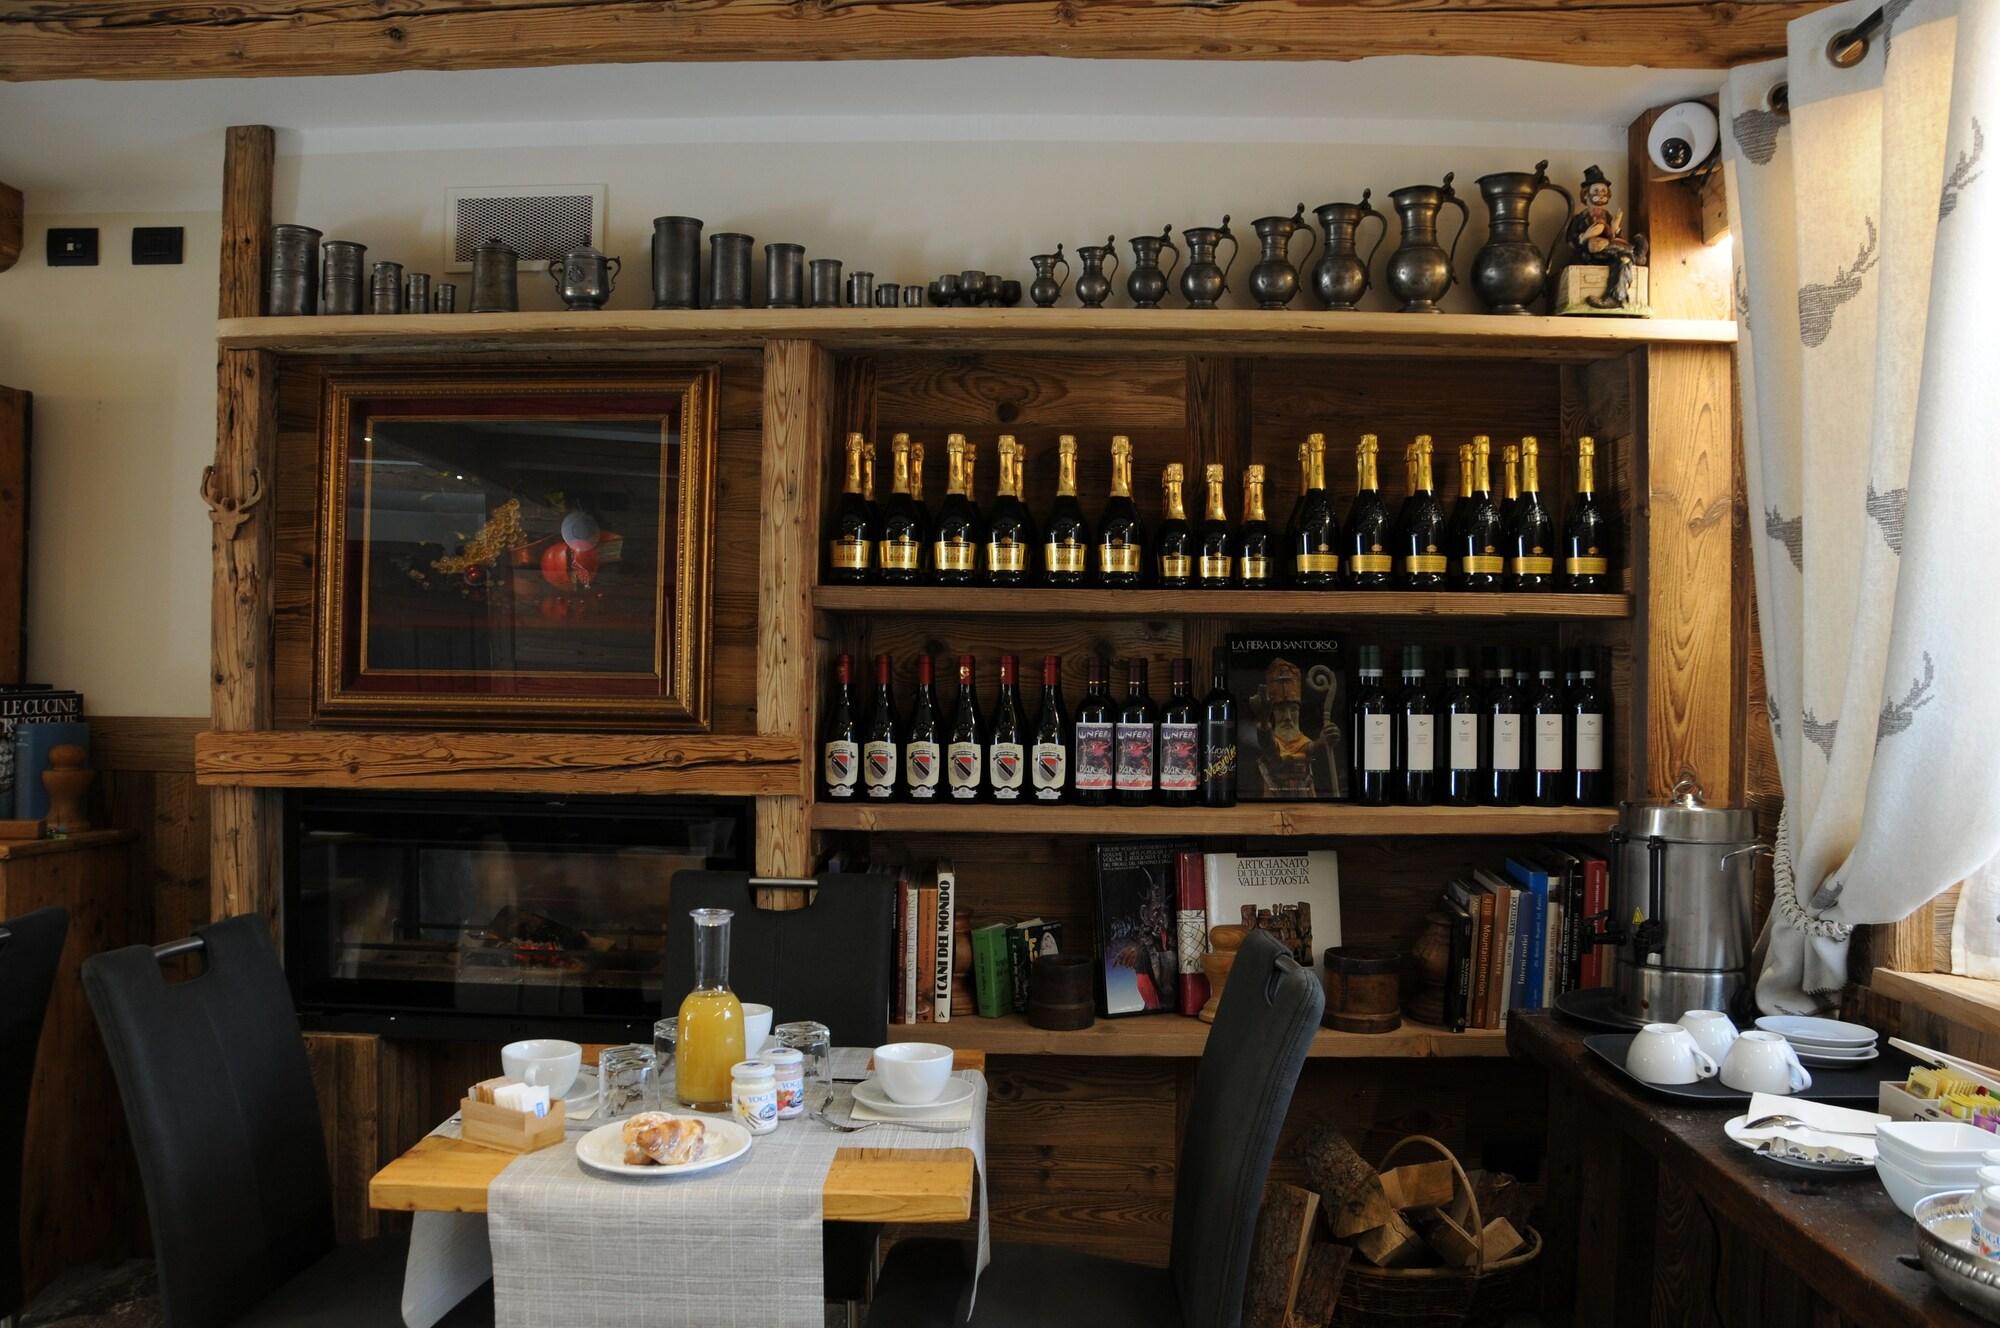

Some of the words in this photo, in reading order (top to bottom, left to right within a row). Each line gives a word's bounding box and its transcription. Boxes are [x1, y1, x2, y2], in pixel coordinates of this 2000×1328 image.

[1231, 640, 1244, 650] LA
[1246, 640, 1269, 650] FIERA
[1271, 640, 1281, 649] DI
[3, 700, 22, 715] LE
[24, 698, 78, 715] CUCINE
[1237, 869, 1246, 877] DI
[1249, 868, 1298, 877] TRADIZIONE
[1300, 867, 1309, 875] IN
[1238, 858, 1309, 870] ARTIGIANATO
[1238, 877, 1268, 887] VALLE
[1270, 875, 1310, 886] D'AOSTA
[938, 879, 950, 932] MONDO
[937, 935, 949, 958] DEL
[1480, 924, 1492, 963] Mountain
[1519, 933, 1529, 958] rustici
[937, 961, 948, 991] CANI
[1478, 963, 1488, 996] Interiors
[1518, 959, 1527, 985] Interni
